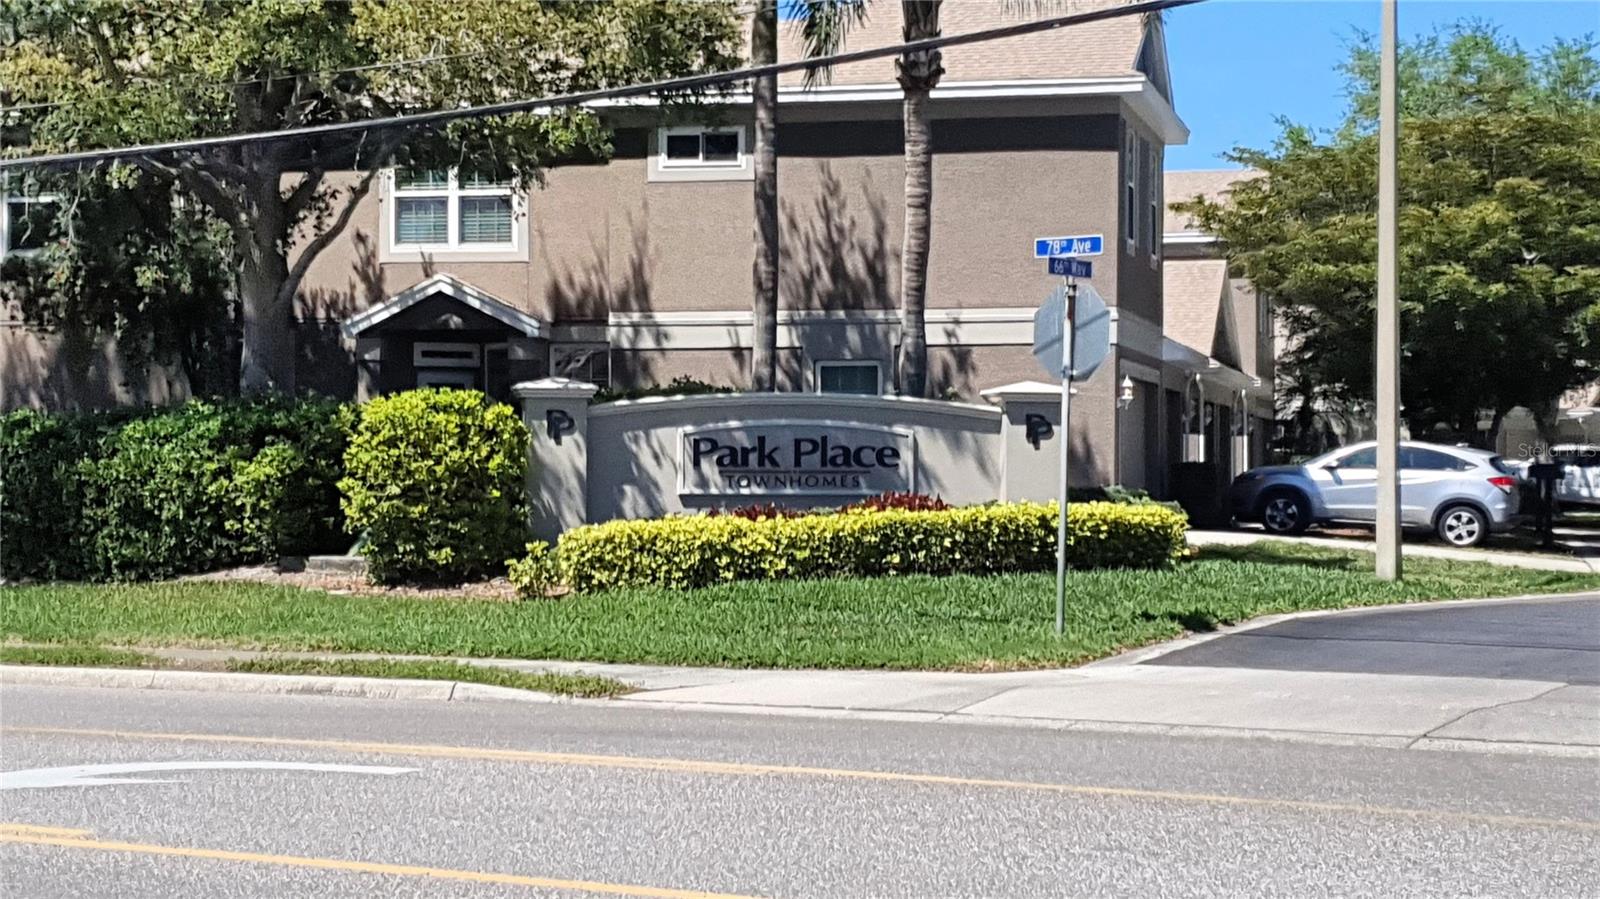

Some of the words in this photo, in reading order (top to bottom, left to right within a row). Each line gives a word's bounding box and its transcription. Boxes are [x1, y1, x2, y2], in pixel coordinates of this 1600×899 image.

[1071, 238, 1091, 254] Ave
[1071, 261, 1087, 275] Way
[693, 435, 780, 469] Park
[793, 435, 900, 469] Place
[726, 474, 861, 488] TOWNHOMES
